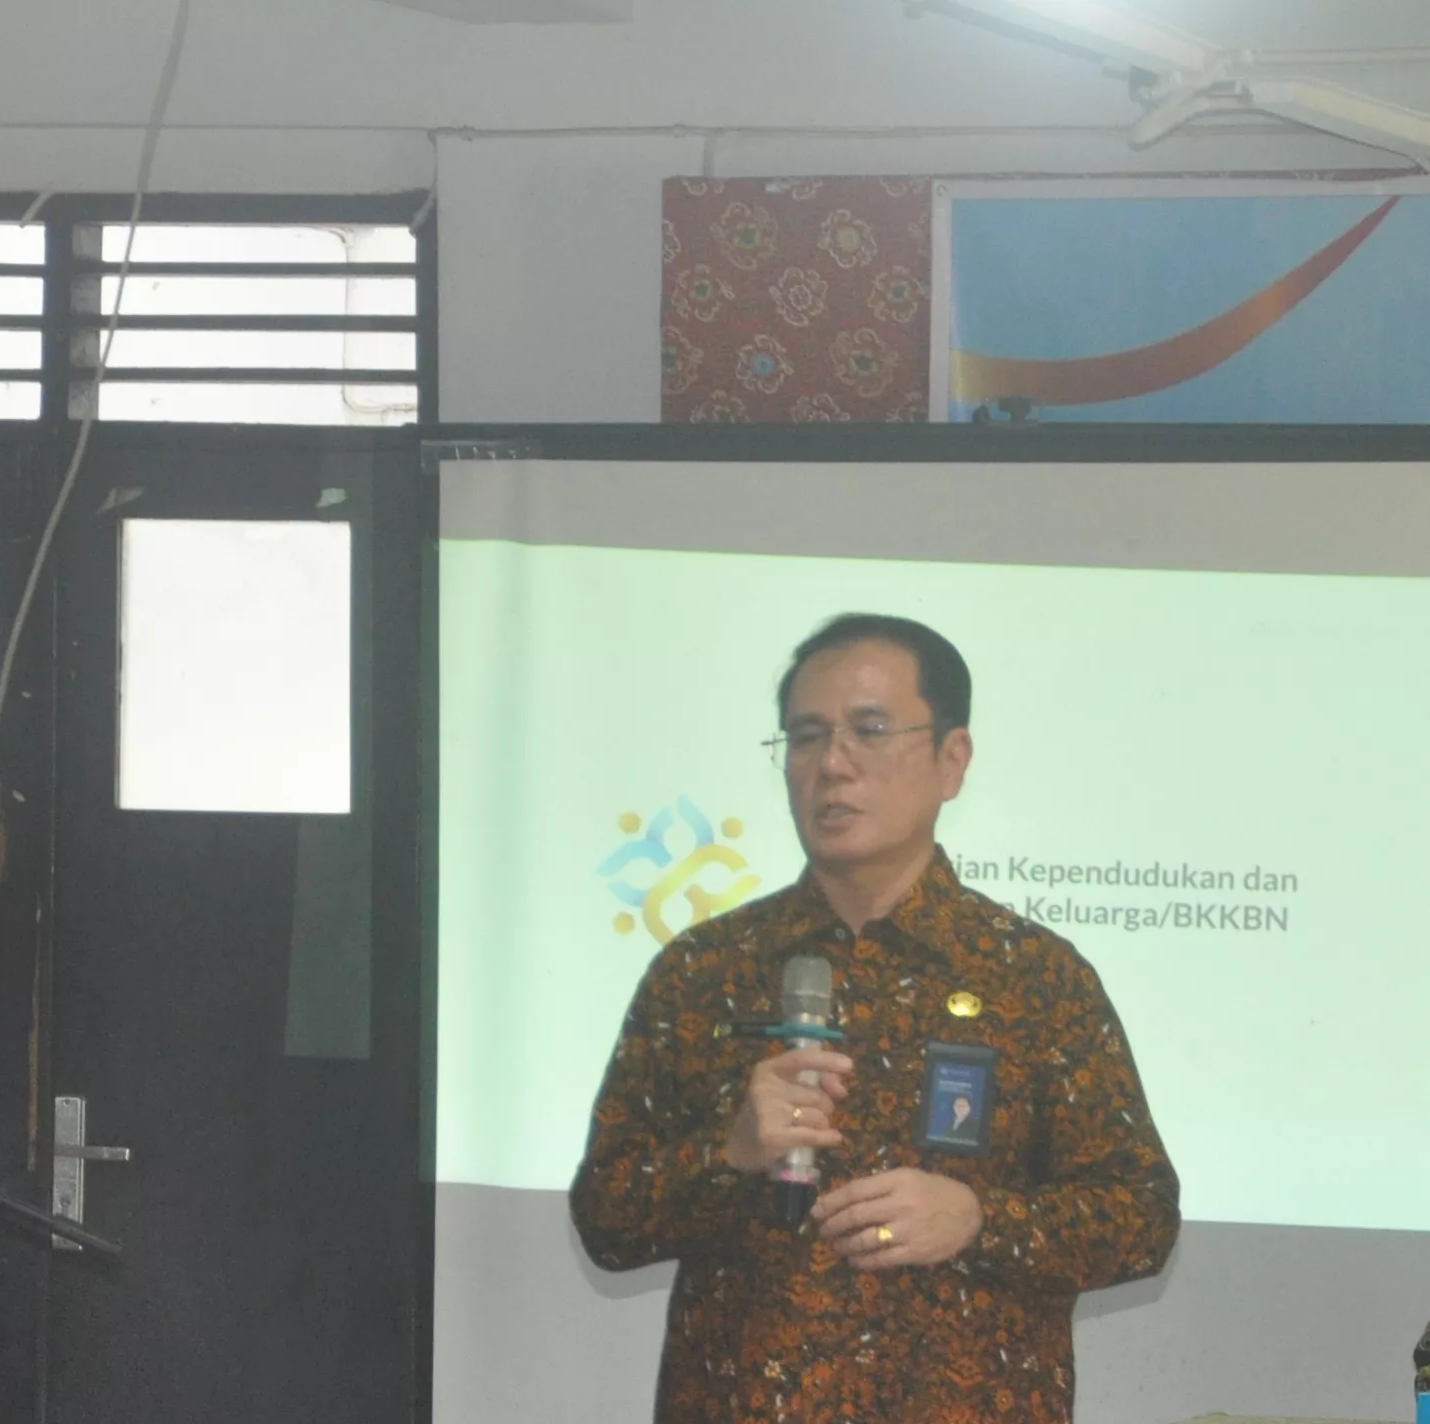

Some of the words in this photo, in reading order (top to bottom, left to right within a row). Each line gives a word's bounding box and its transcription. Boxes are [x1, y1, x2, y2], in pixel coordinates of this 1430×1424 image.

[955, 853, 1000, 881] ian
[1008, 854, 1236, 893] Kependudukan
[1243, 863, 1299, 893] dan
[1024, 898, 1290, 934] Keluarga/BKKBN
